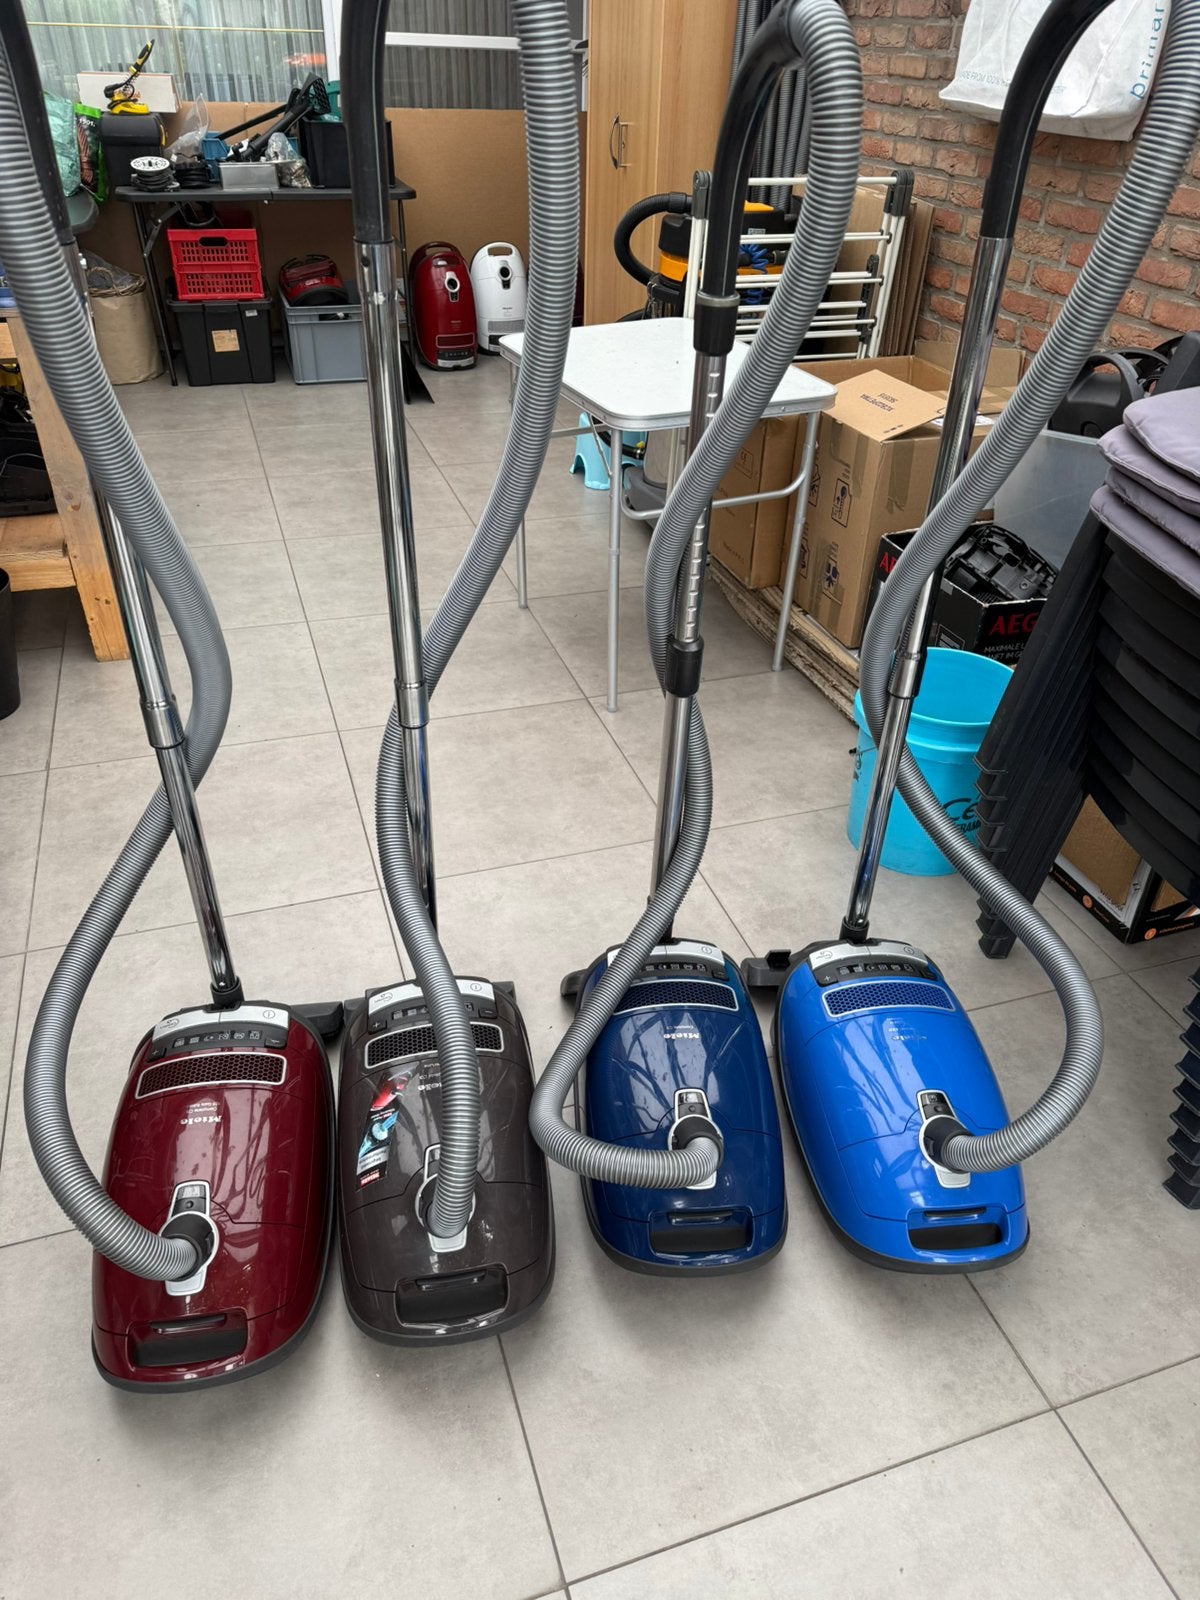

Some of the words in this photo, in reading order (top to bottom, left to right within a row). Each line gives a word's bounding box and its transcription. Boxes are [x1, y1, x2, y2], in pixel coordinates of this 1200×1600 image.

[1130, 0, 1165, 100] primar
[989, 612, 1039, 636] AEG
[664, 1032, 700, 1040] Miele
[180, 1115, 222, 1125] Miele
